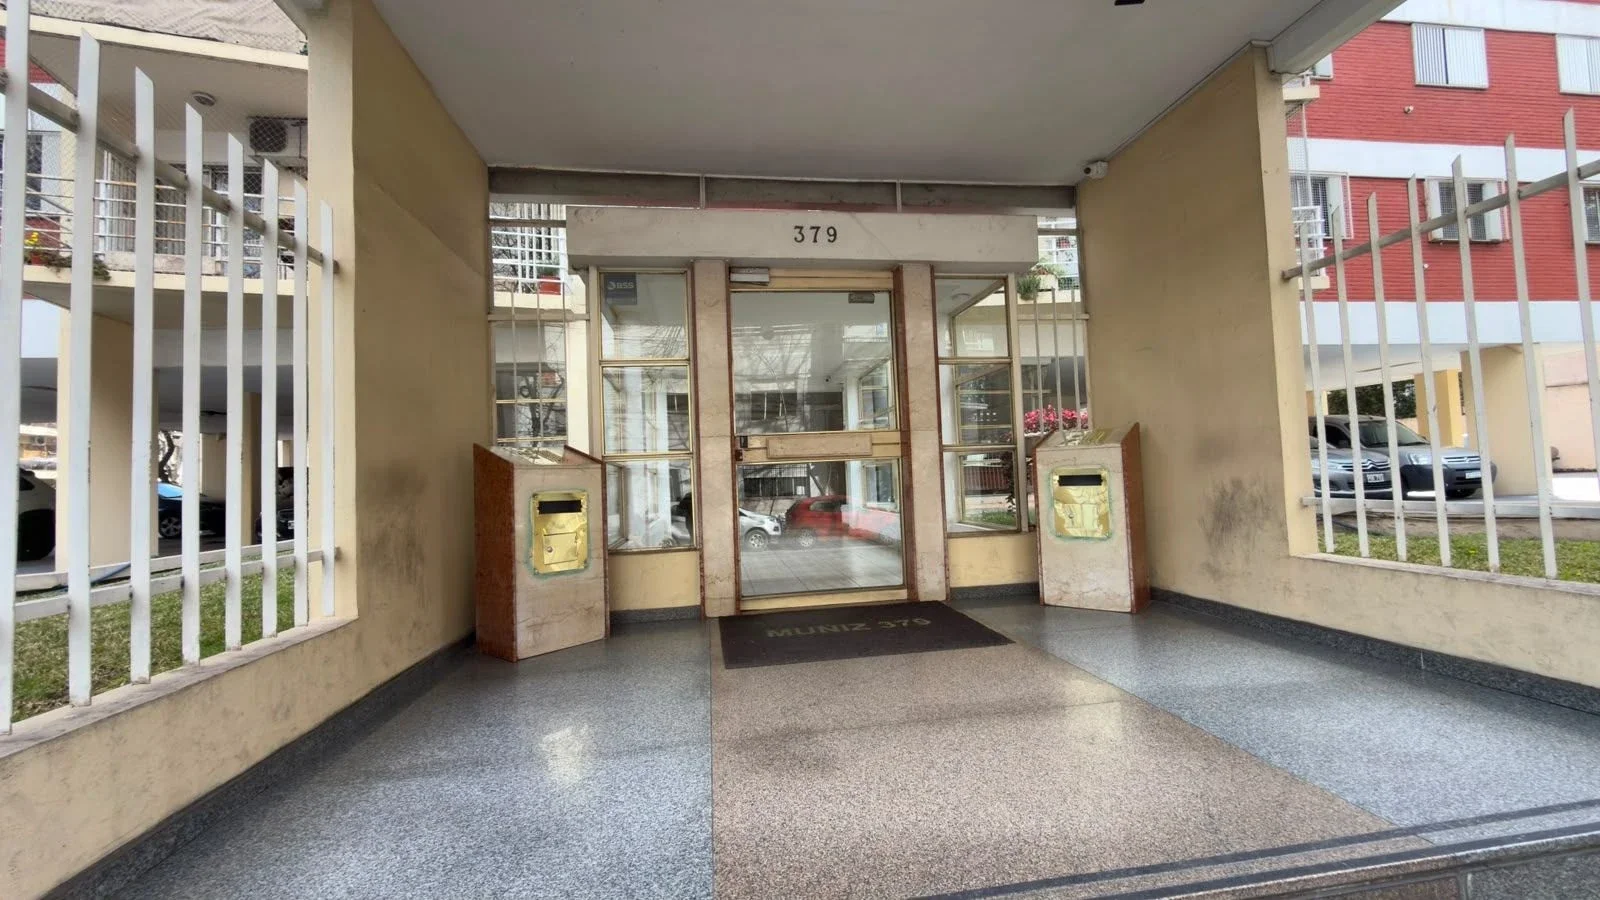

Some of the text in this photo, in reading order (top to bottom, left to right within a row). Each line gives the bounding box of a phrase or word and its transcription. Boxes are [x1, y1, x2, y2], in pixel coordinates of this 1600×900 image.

[794, 225, 837, 243] 379
[767, 617, 931, 638] MUNIZ 379
